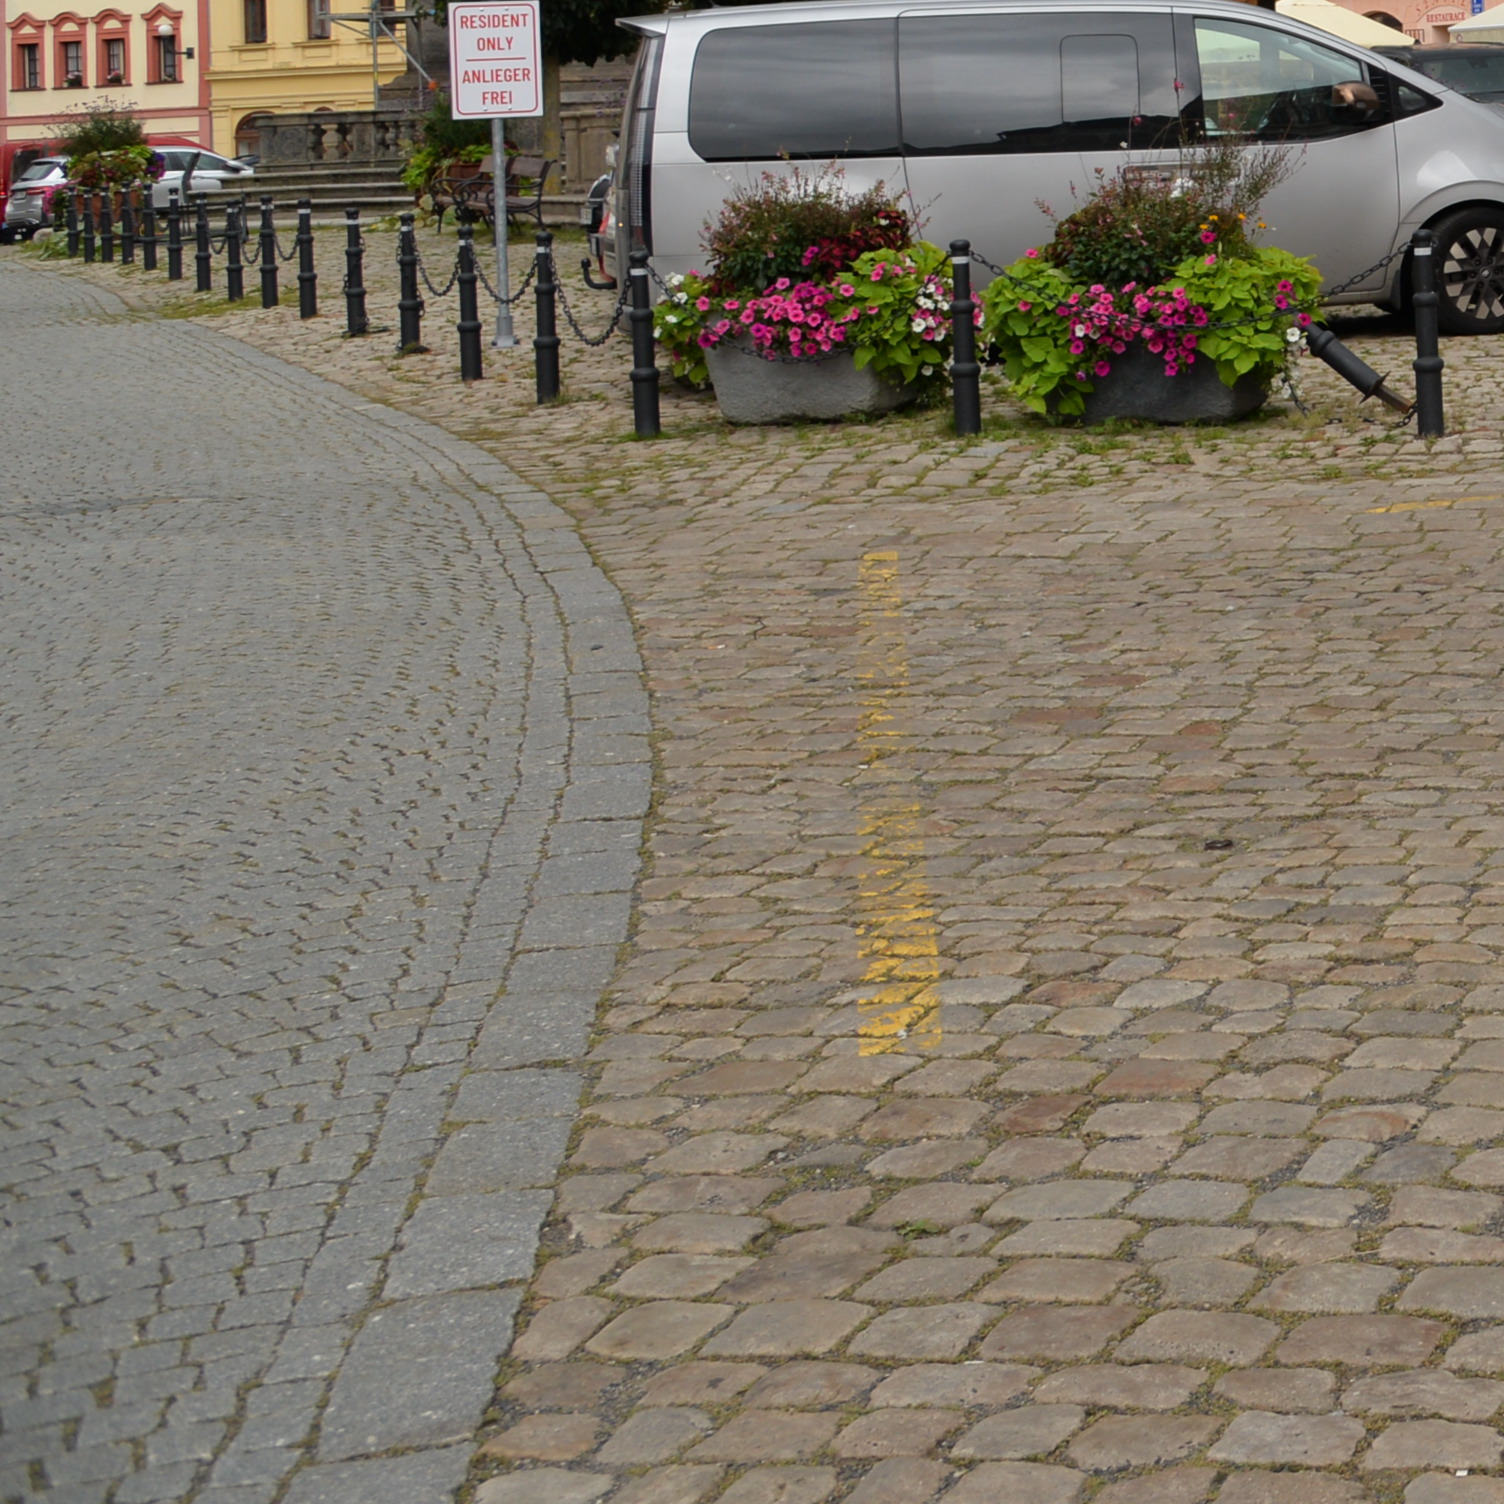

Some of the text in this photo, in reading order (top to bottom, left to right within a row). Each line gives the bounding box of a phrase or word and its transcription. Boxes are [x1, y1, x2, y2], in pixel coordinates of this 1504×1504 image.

[460, 13, 529, 29] RESIDENT
[1426, 12, 1466, 23] RESTAURACE
[476, 36, 514, 51] ONLY
[462, 68, 531, 84] ANLIEGER
[482, 91, 513, 105] FREI
